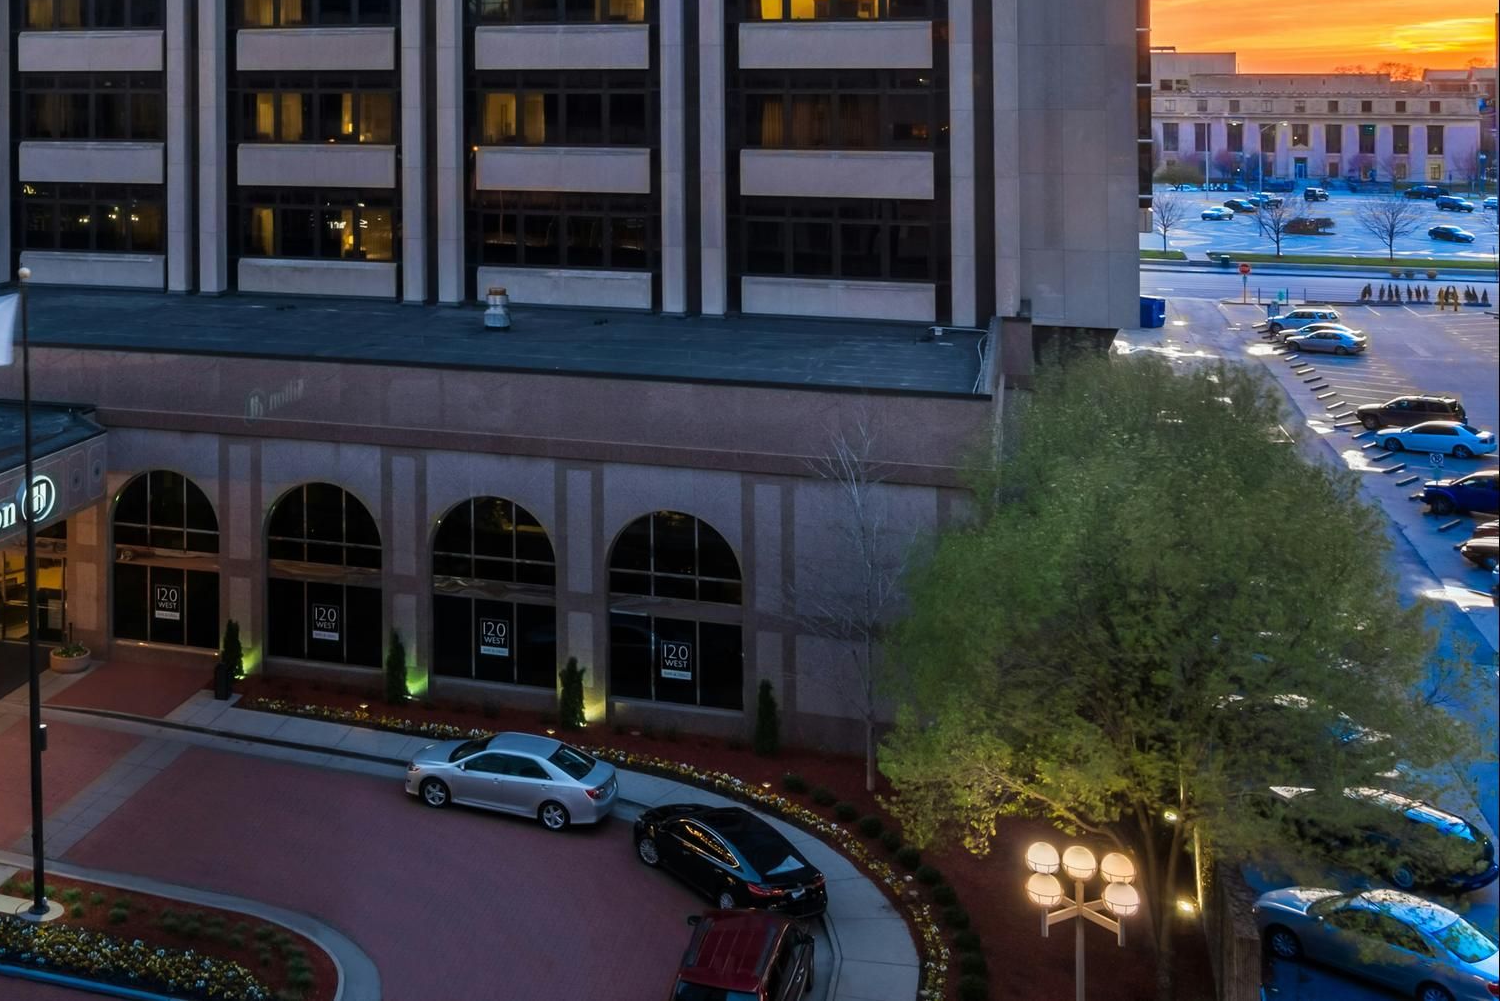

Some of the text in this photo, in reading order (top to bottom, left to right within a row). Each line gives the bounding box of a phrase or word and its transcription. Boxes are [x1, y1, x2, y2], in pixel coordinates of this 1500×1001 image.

[157, 588, 178, 602] 120
[158, 601, 177, 609] WEST
[315, 607, 337, 622] 120
[316, 621, 336, 630] WEST
[483, 621, 506, 637] 120
[484, 636, 505, 646] WEST
[664, 643, 689, 660] 120
[665, 659, 688, 668] WEST
